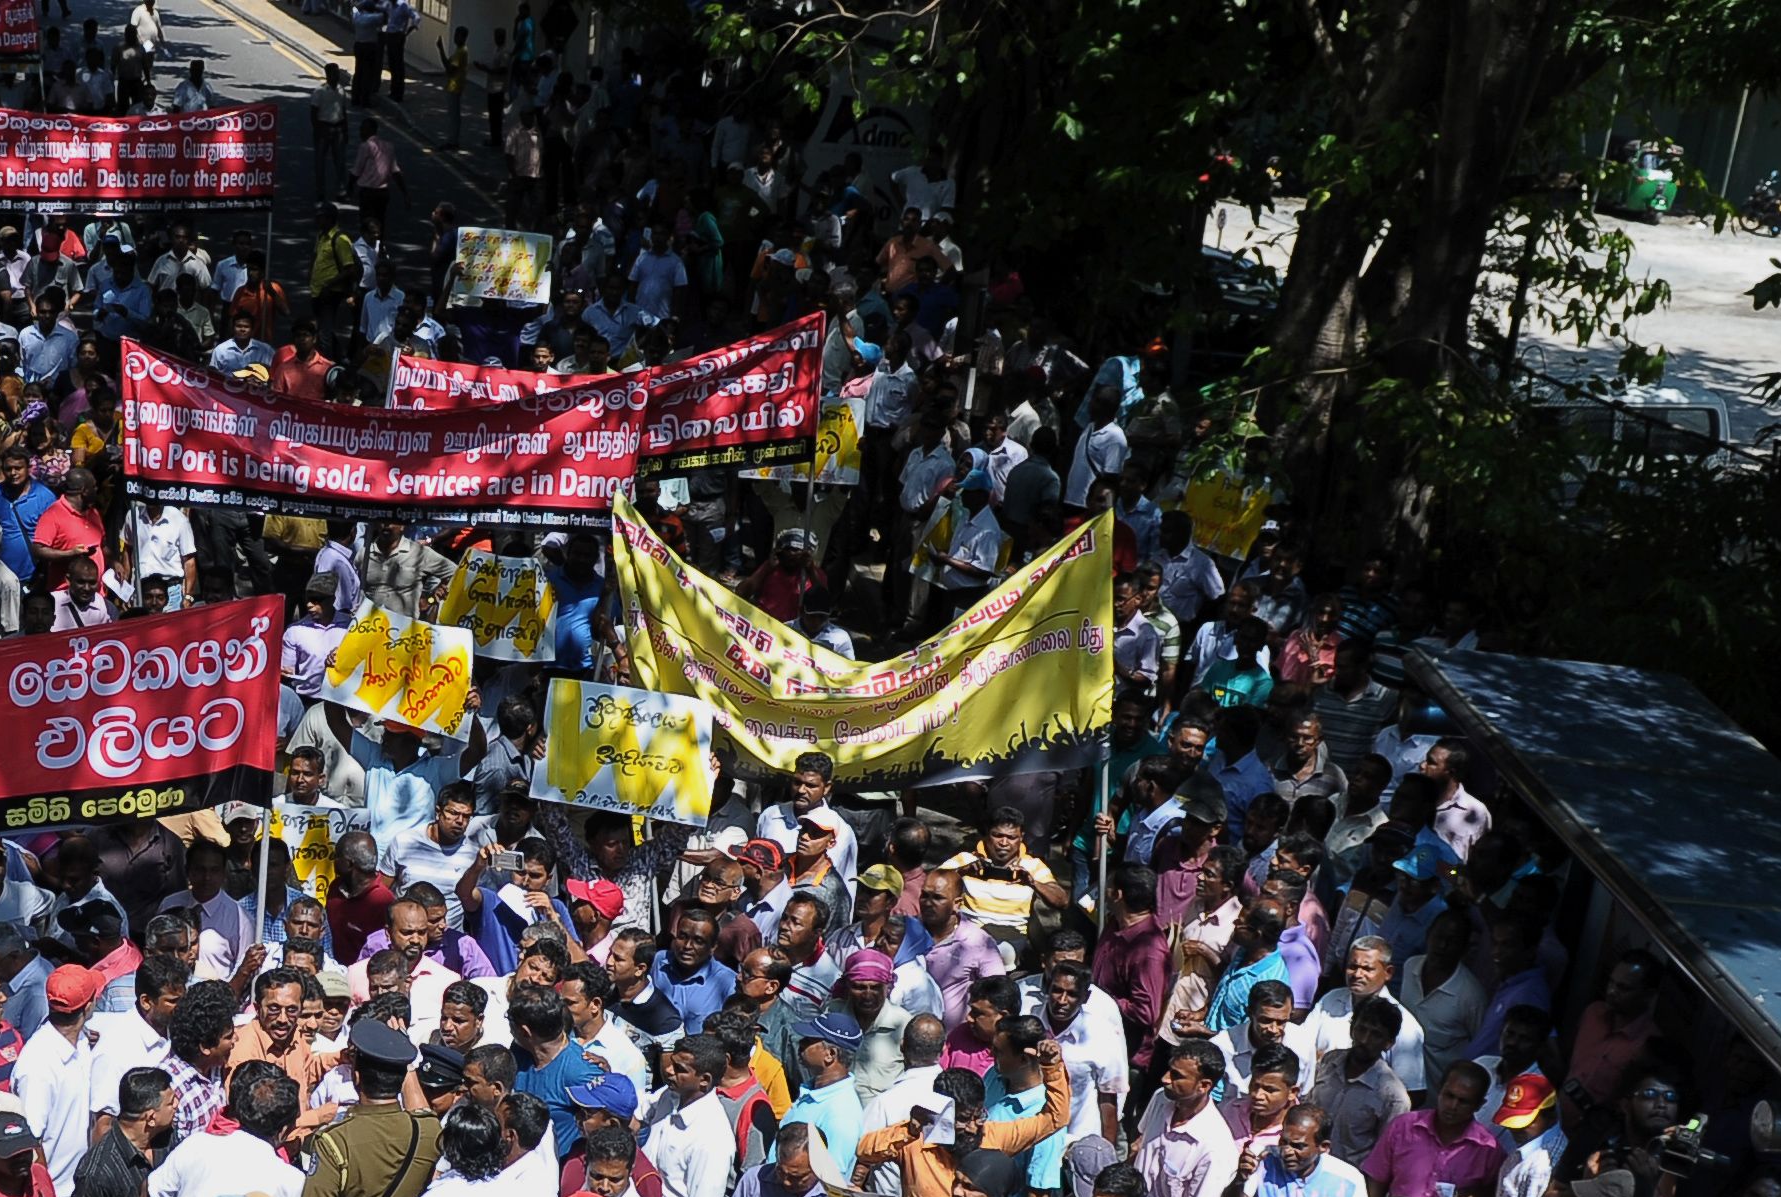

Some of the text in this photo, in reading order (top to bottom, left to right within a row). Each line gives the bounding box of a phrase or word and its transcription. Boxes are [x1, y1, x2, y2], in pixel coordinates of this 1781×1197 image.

[2, 31, 37, 49] Danger
[6, 168, 50, 193] being
[52, 168, 88, 188] sold.
[97, 169, 140, 188] Debts
[142, 173, 167, 187] are
[169, 169, 191, 187] for
[193, 168, 217, 187] the
[219, 168, 272, 193] peoples
[648, 400, 806, 449] நிலையில்
[125, 437, 163, 470] The
[168, 443, 216, 474] Port
[222, 449, 244, 476] is
[245, 453, 310, 493] being
[315, 463, 371, 493] sold.
[386, 467, 482, 497] Services
[487, 475, 524, 496] are
[531, 467, 553, 496] in
[1077, 618, 1104, 655] மீது
[8, 616, 271, 707] සේවකයන්
[35, 697, 245, 779] එලියට
[744, 715, 818, 744] வைக்க
[5, 797, 71, 825] සමිති
[81, 788, 185, 819] පෙරමුණ
